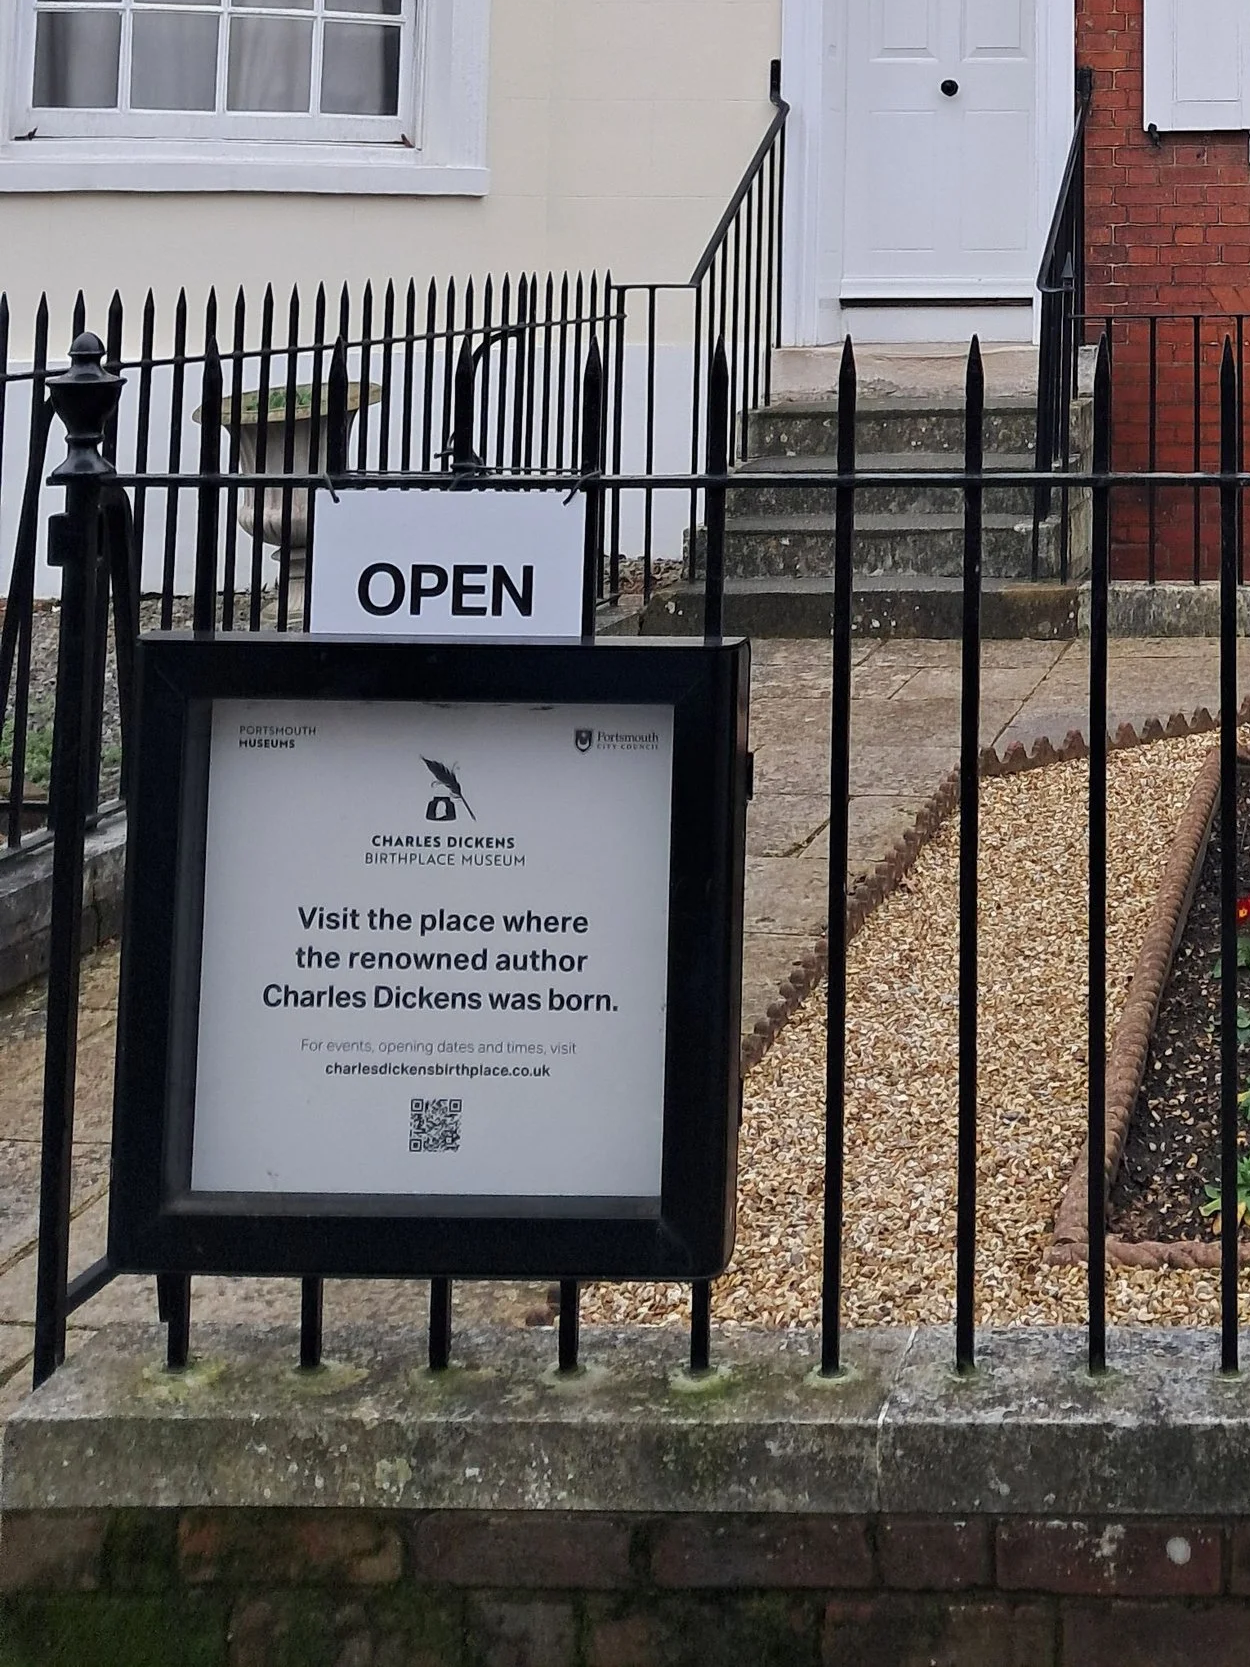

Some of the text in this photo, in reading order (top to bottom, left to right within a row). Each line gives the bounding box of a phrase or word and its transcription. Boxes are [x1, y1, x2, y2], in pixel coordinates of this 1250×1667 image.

[357, 562, 534, 617] OPEN
[239, 725, 317, 737] PORTSMOUTH
[597, 730, 659, 743] Portsmouth
[239, 738, 296, 749] MUSEUMS
[371, 835, 516, 850] CHARLES DICKENS
[364, 851, 526, 868] BIRTHPLACE MUSEUM
[298, 906, 590, 938] Visit the place where
[295, 946, 589, 973] the renowned author
[263, 984, 619, 1013] Charles Dickens was born.
[301, 1039, 577, 1056] For events, opening dates and times, visit
[325, 1062, 551, 1079] charlesdickensbirthplace.co.uk
